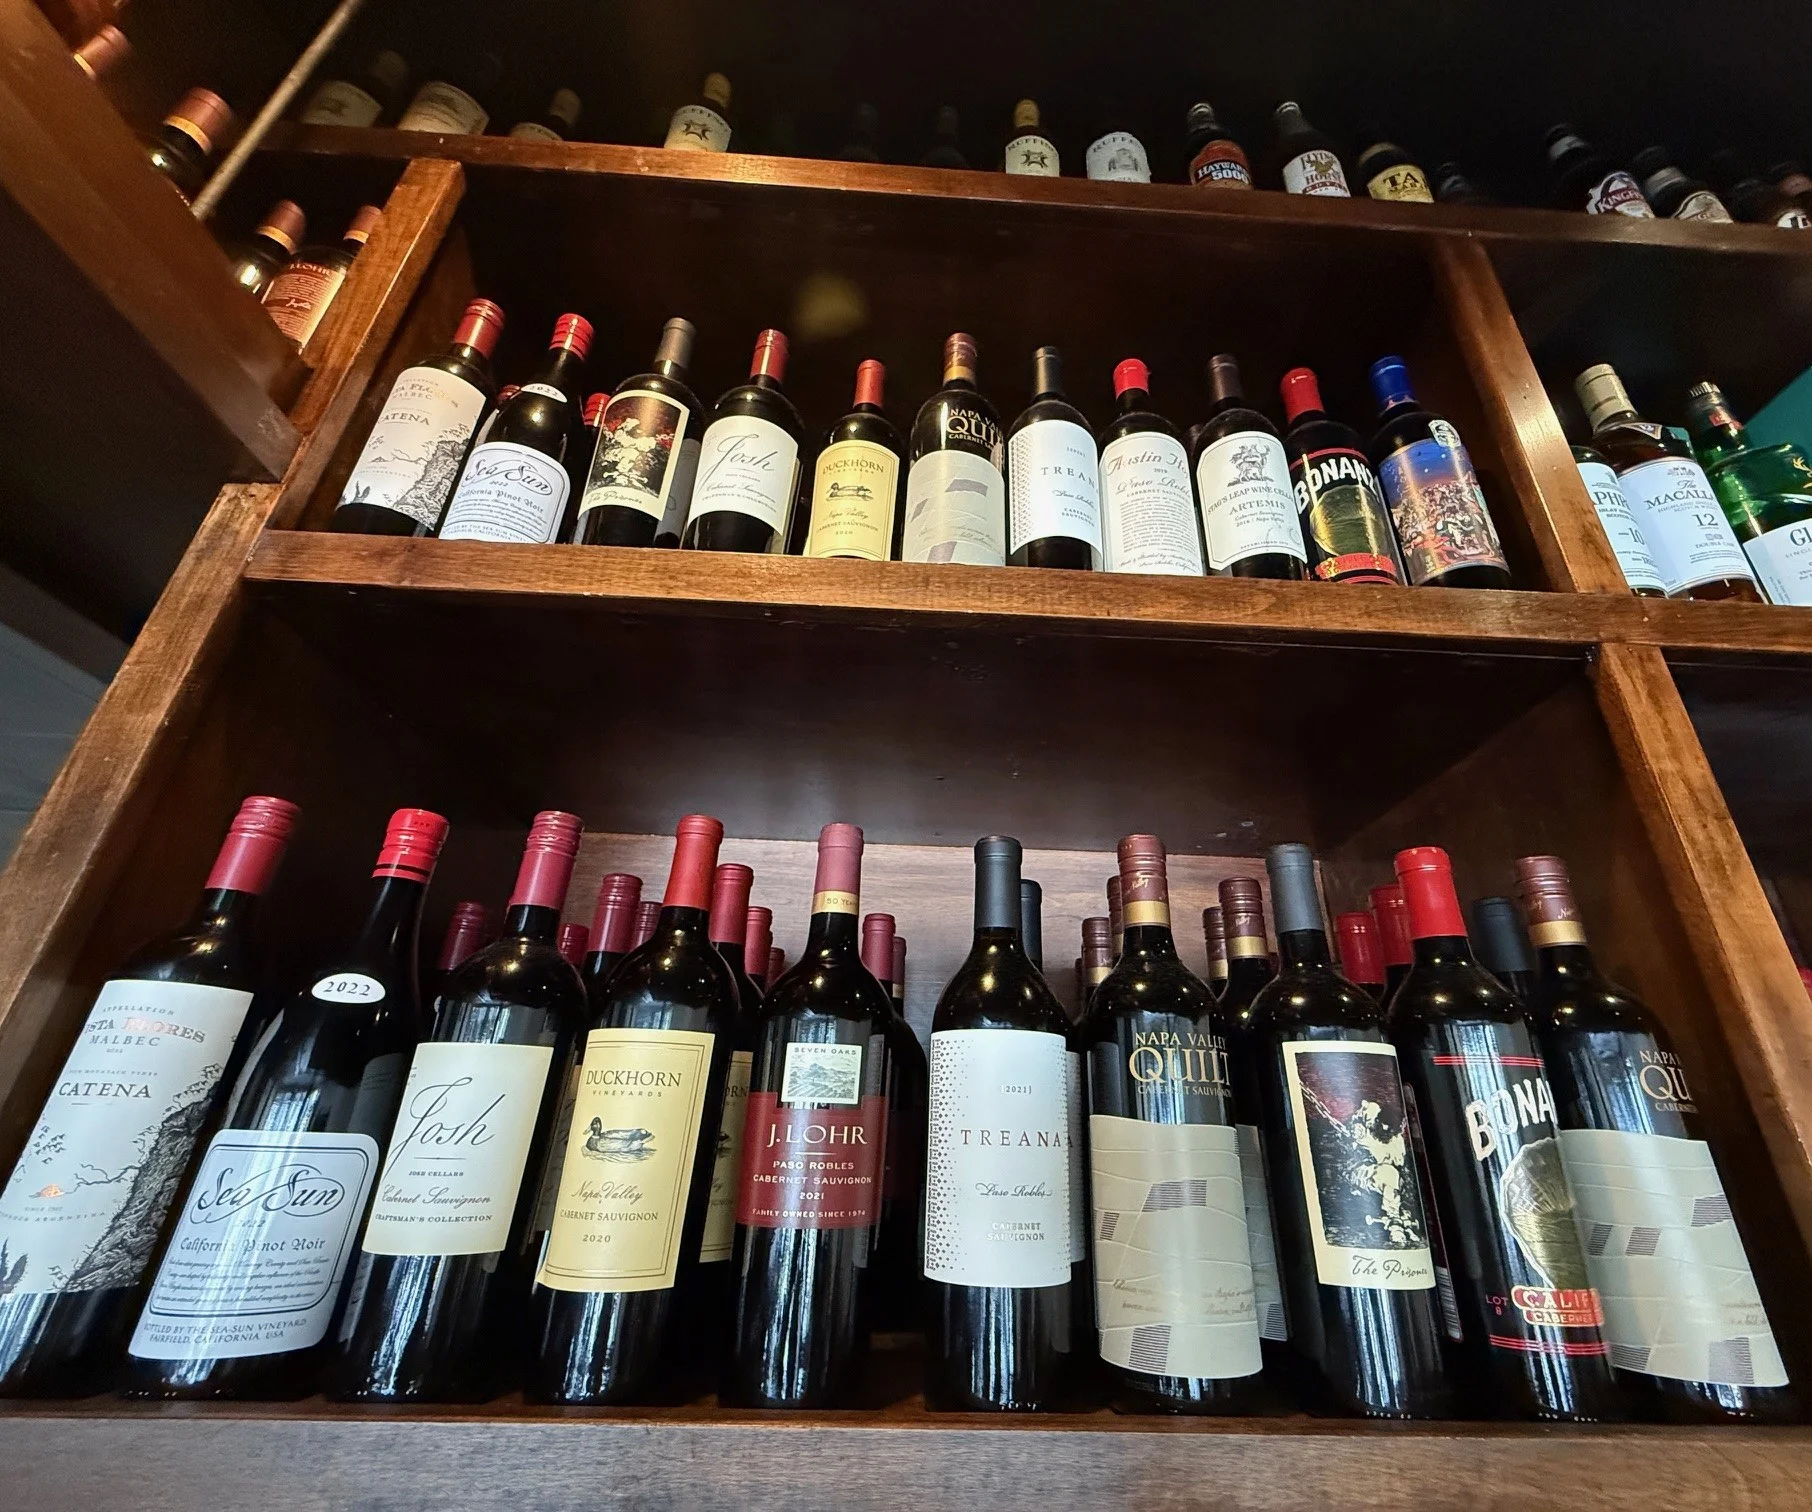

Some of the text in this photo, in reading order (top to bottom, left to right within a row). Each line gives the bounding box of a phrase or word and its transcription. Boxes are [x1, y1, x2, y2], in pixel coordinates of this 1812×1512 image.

[1211, 169, 1249, 185] 5000
[530, 386, 558, 397] 2022
[950, 408, 981, 421] NAPA
[694, 434, 779, 498] Josh
[822, 459, 885, 475] DUCKHORN
[465, 459, 548, 492] Sea Sun
[1677, 480, 1697, 490] The
[496, 489, 522, 502] Pinot
[1207, 494, 1228, 515] STAG'S
[1228, 487, 1250, 500] LEAP
[1251, 485, 1273, 494] WINE
[1229, 499, 1286, 515] ARTEMIS
[1692, 513, 1718, 527] 12
[323, 981, 371, 997] 2022
[89, 1034, 161, 1047] MALBEC
[1135, 1031, 1226, 1049] NAPA VALLEY
[794, 1046, 830, 1054] SEVEN
[1129, 1046, 1231, 1087] QUILT
[586, 1070, 682, 1087] DUCKHORN
[58, 1082, 152, 1098] CATENA
[592, 1089, 663, 1098] VINEYARDS
[382, 1077, 506, 1183] Josh
[961, 1129, 1061, 1148] TREANA
[773, 1160, 855, 1170] PASO ROBLES
[753, 1174, 872, 1185] CABERNET SAUVIGNON
[197, 1167, 337, 1212] Sea Sun
[571, 1181, 644, 1206] Napa Valley
[799, 1191, 825, 1200] 2021
[975, 1181, 1052, 1198] Paso Robles
[381, 1184, 491, 1210] Cabernet Sauvignon
[375, 1213, 493, 1223] CRAFTSMAN'S COLLECTION
[560, 1209, 659, 1222] CABERNET SAUVIGNON
[752, 1208, 780, 1217] FAMILY
[782, 1209, 815, 1218] OWNED
[817, 1210, 845, 1218] SINCE
[992, 1222, 1041, 1231] CABERNET
[292, 1237, 326, 1251] Noir
[582, 1234, 612, 1243] 2020
[987, 1232, 1045, 1242] SAUVIGNON
[1351, 1254, 1378, 1276] The
[1486, 1294, 1509, 1306] LOT
[174, 1323, 184, 1333] BY
[266, 1330, 284, 1340] USA
